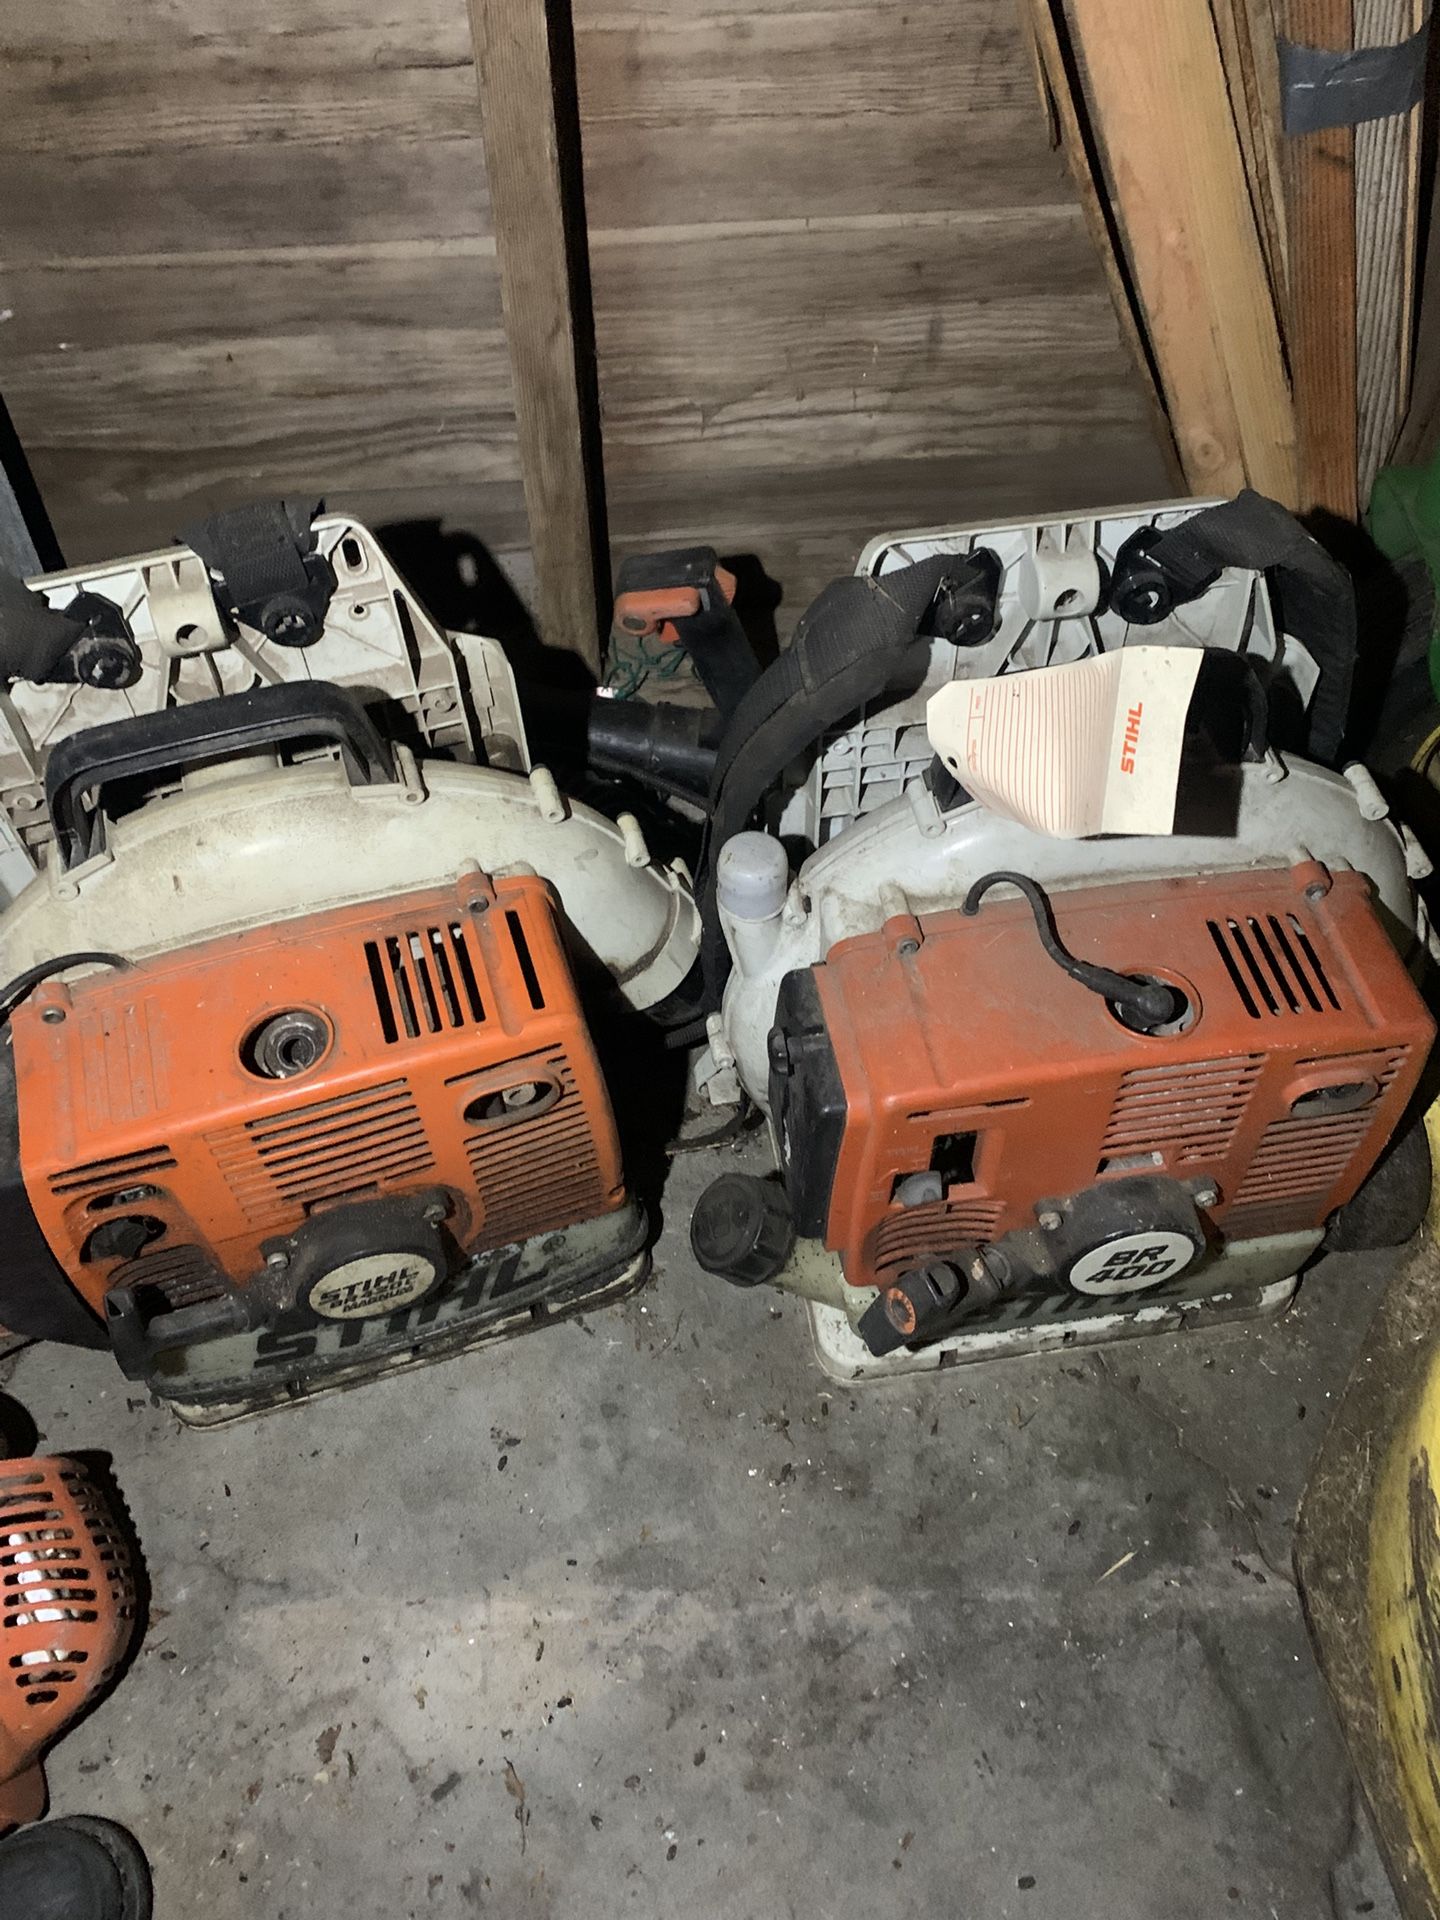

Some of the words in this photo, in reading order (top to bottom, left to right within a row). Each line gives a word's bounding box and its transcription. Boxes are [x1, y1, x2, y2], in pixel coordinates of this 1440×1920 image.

[1120, 701, 1143, 775] STIHL
[1103, 1244, 1169, 1268] BR
[1085, 1258, 1177, 1284] 400
[318, 1267, 420, 1307] STIHL
[343, 1285, 414, 1313] MAGNUM
